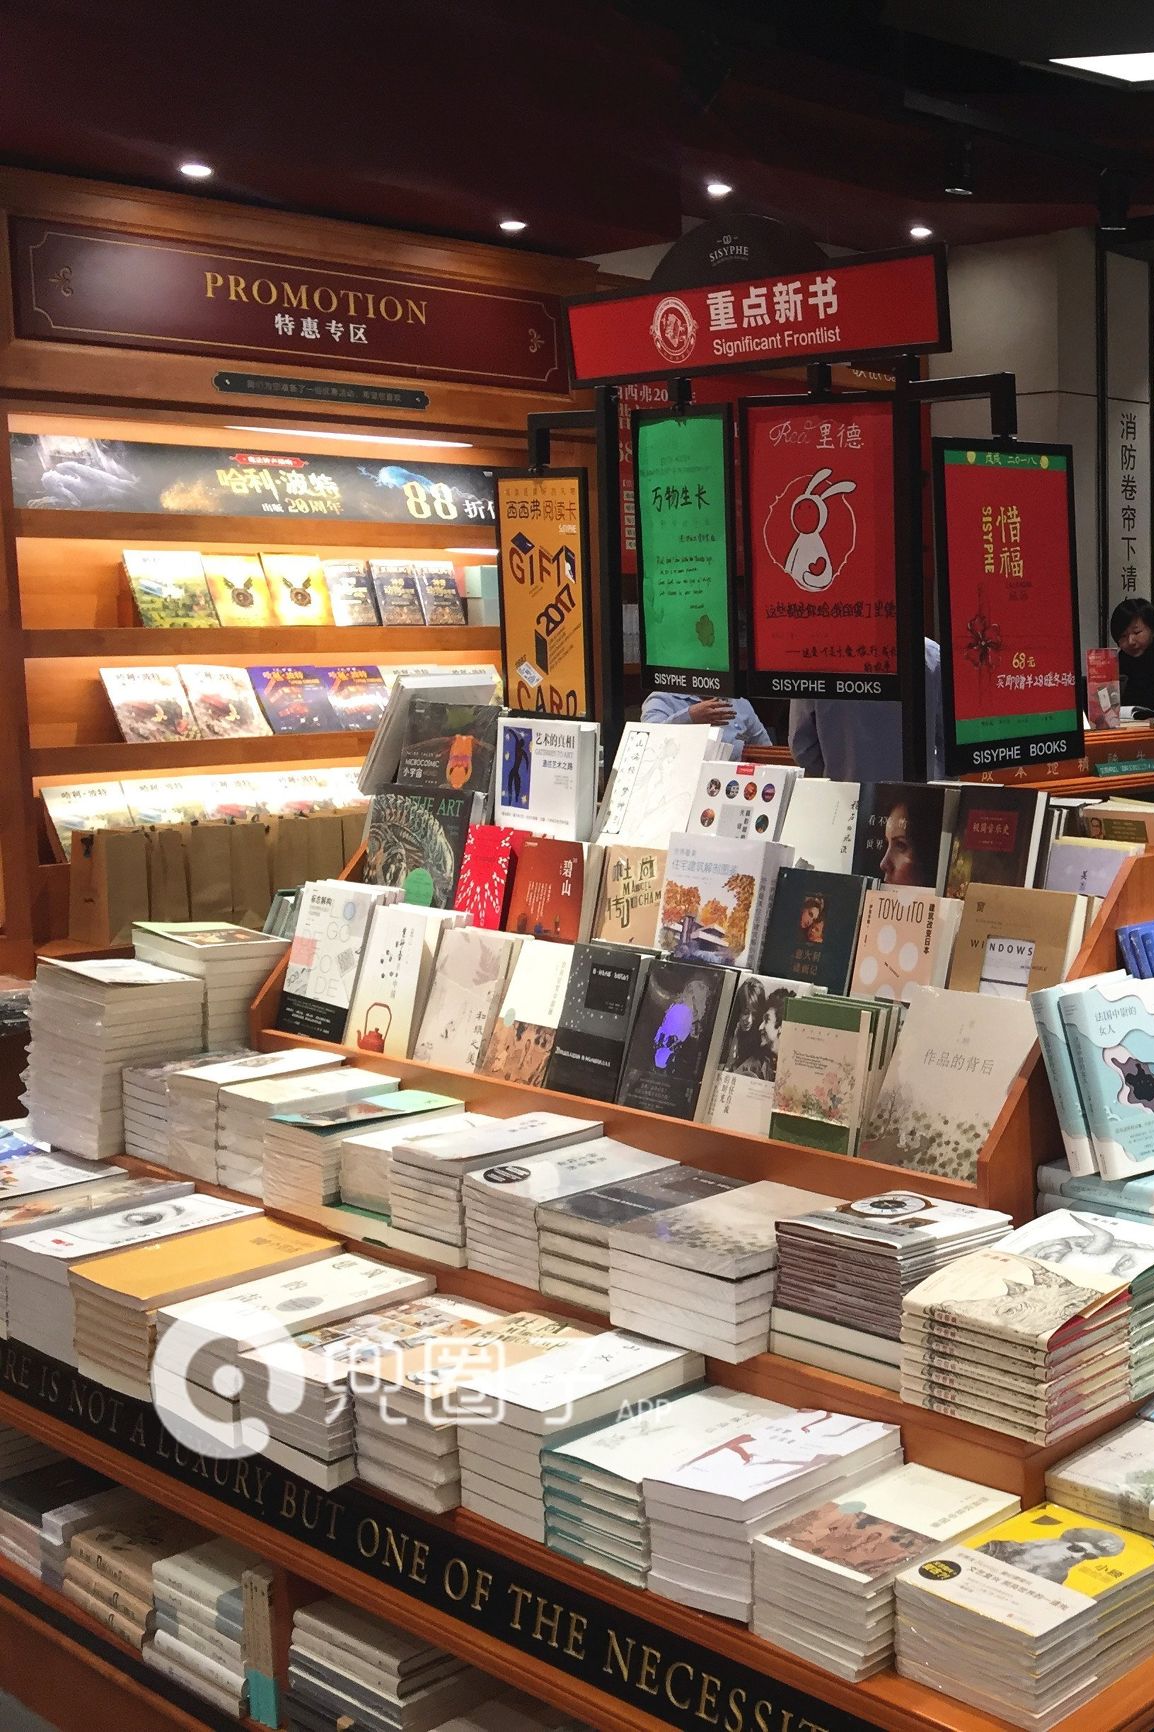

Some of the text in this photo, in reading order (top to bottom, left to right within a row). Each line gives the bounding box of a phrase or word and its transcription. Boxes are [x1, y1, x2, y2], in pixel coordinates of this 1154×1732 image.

[709, 245, 749, 263] SISYPHE
[205, 271, 428, 325] PROMOTION
[706, 276, 840, 332] 重点新书
[274, 314, 368, 344] 特惠专区
[712, 326, 841, 357] Significant Frontlist
[403, 481, 458, 520] 88
[1119, 412, 1138, 602] 消防卷帘下请
[981, 506, 994, 574] SISYPHE
[536, 583, 577, 638] 2017
[654, 673, 720, 690] SISYPHE BOOKS
[772, 678, 882, 694] SISYPHE BOOKS
[973, 739, 1068, 766] SISYPHE BOOKS
[438, 799, 464, 817] ART
[970, 937, 1033, 958] WINDOWS
[924, 1048, 995, 1077] 作品的背后
[41, 1365, 61, 1403] IS
[68, 1379, 124, 1433] NOT
[130, 1411, 147, 1448] A
[156, 1420, 272, 1506] LUXURY
[280, 1482, 345, 1541] BUT
[357, 1517, 431, 1585] ONE
[444, 1557, 493, 1613] OF
[507, 1582, 588, 1660] THE
